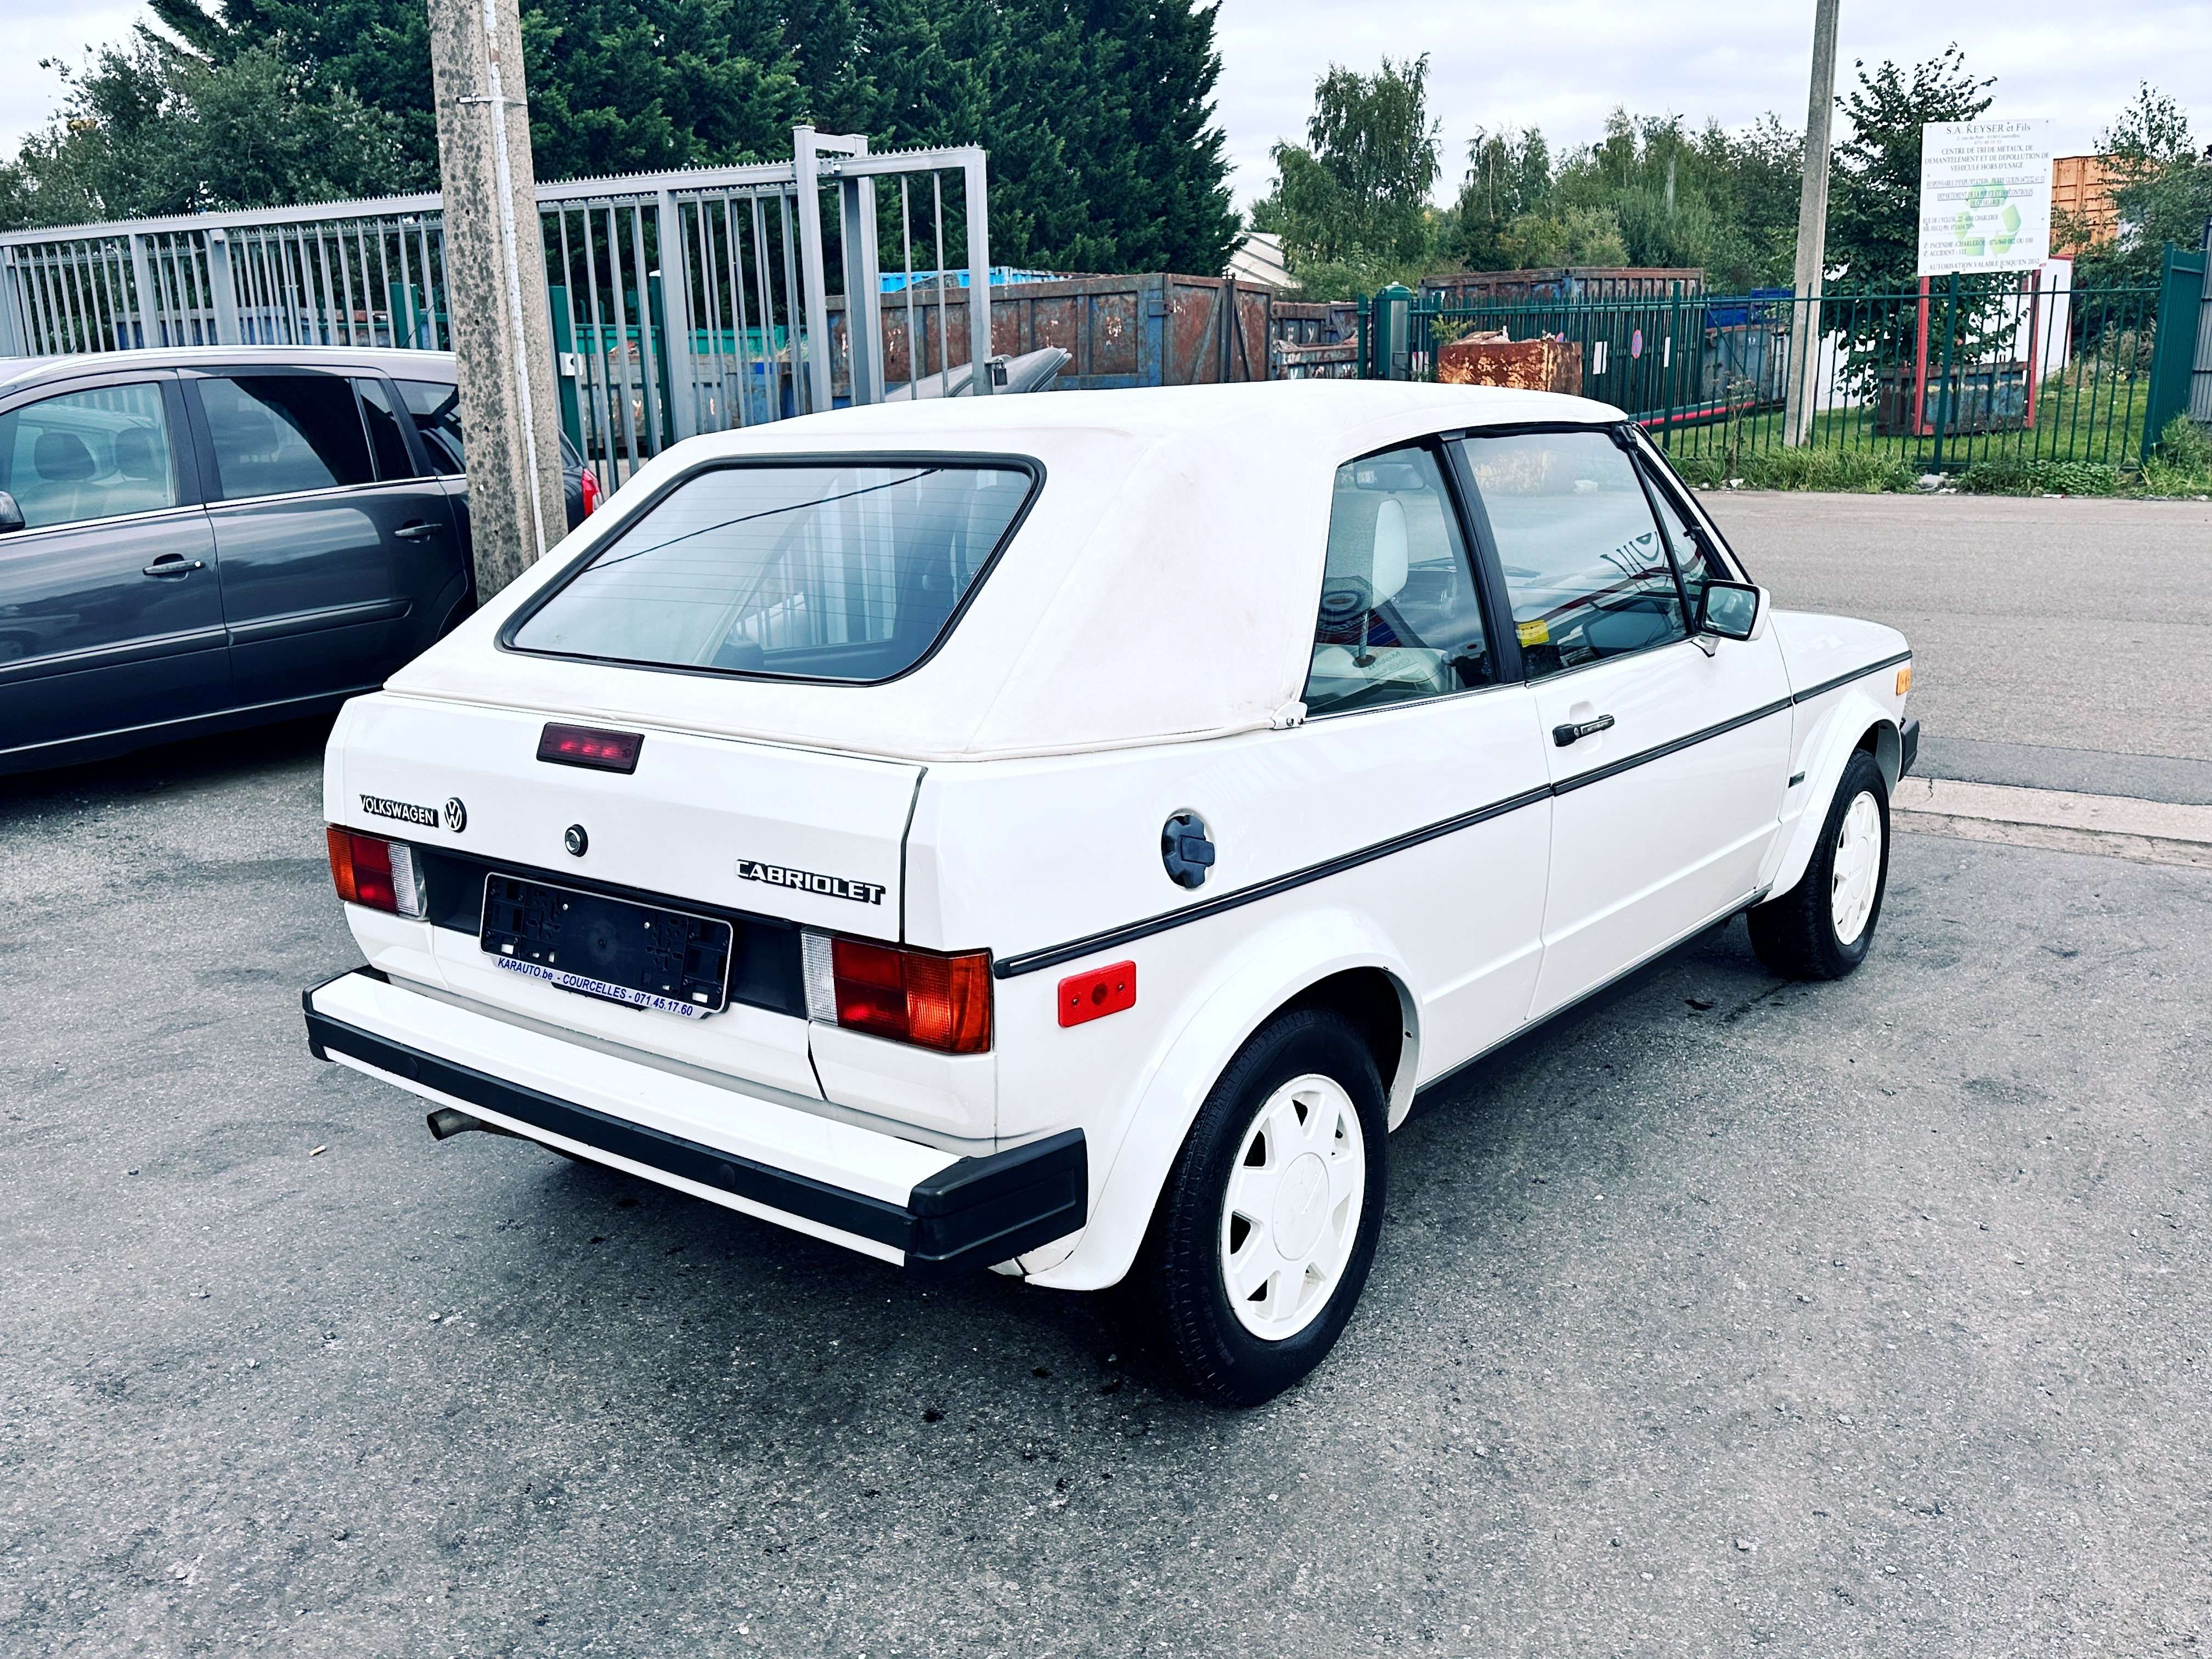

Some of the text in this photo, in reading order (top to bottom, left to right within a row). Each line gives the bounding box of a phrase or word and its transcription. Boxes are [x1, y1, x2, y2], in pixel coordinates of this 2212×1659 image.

[1966, 124, 2004, 133] KEYSER
[2006, 123, 2013, 132] et
[2016, 123, 2031, 131] Fils
[1925, 155, 1979, 165] DEMANTELEMENT
[1999, 153, 2040, 161] DEPOLLUTION
[1929, 262, 1972, 271] AUTORISATION
[1974, 260, 1998, 268] VALABLE
[359, 794, 466, 833] VOLKSWAGEN VW
[736, 859, 885, 905] CABRIOLET
[498, 957, 553, 981] KARAUTO.be
[563, 974, 627, 1000] COURCELLES
[634, 993, 693, 1017] 071.45.17.60
